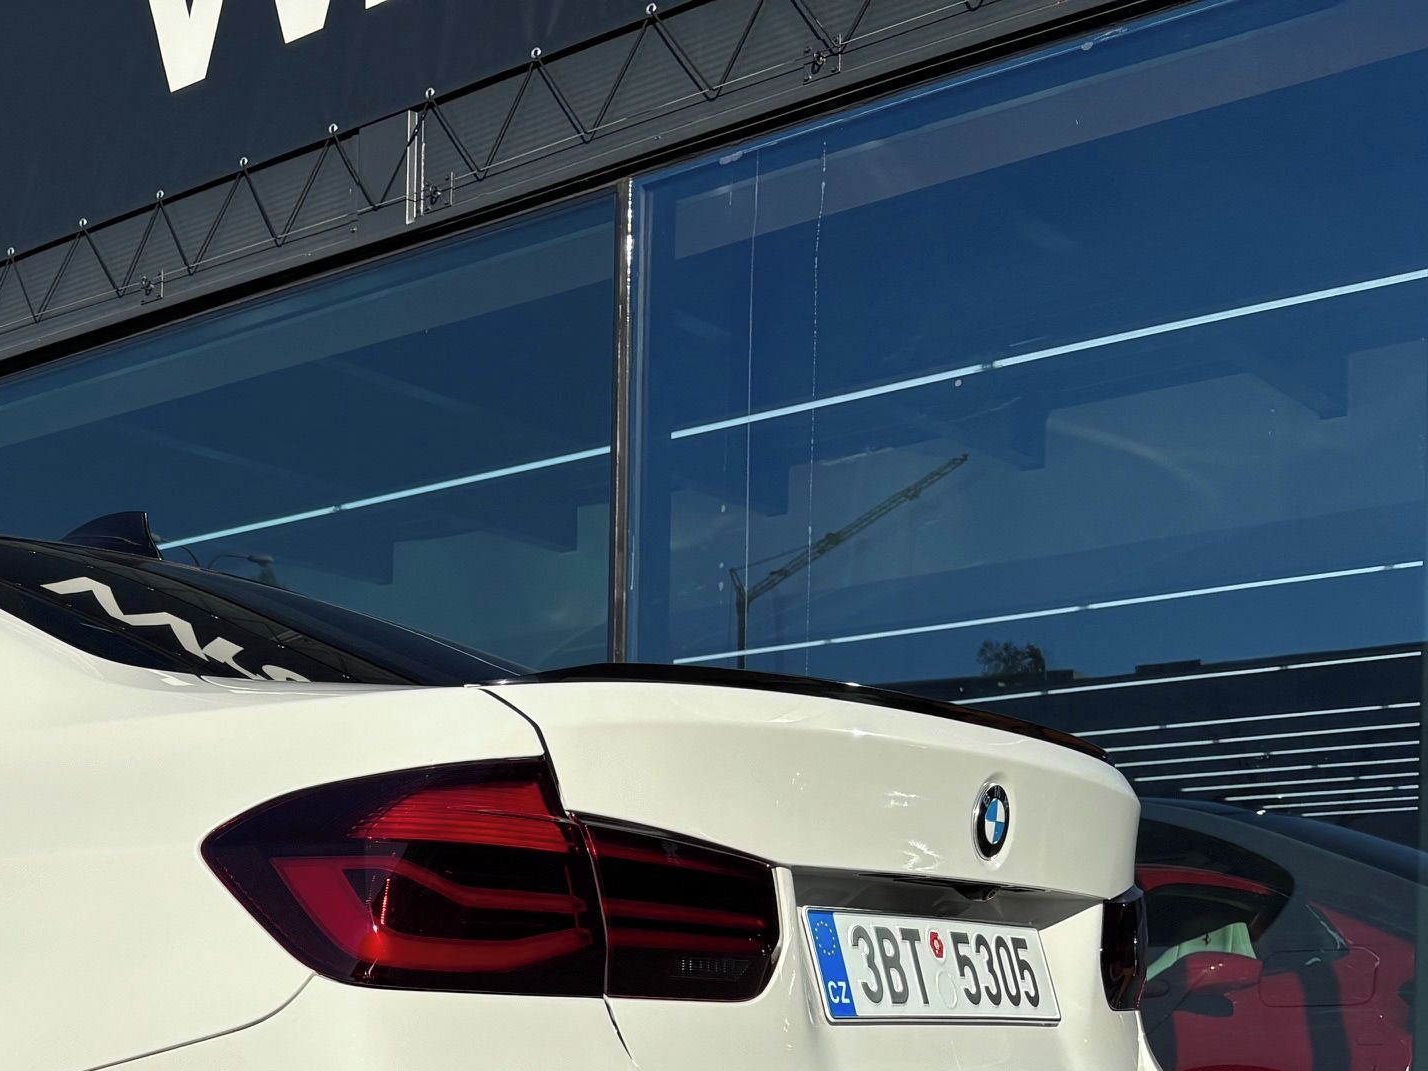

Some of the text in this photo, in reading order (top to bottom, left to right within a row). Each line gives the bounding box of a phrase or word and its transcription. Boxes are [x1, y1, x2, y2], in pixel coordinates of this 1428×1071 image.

[827, 980, 850, 1004] CZ
[851, 925, 1040, 1007] 3BT 5305
